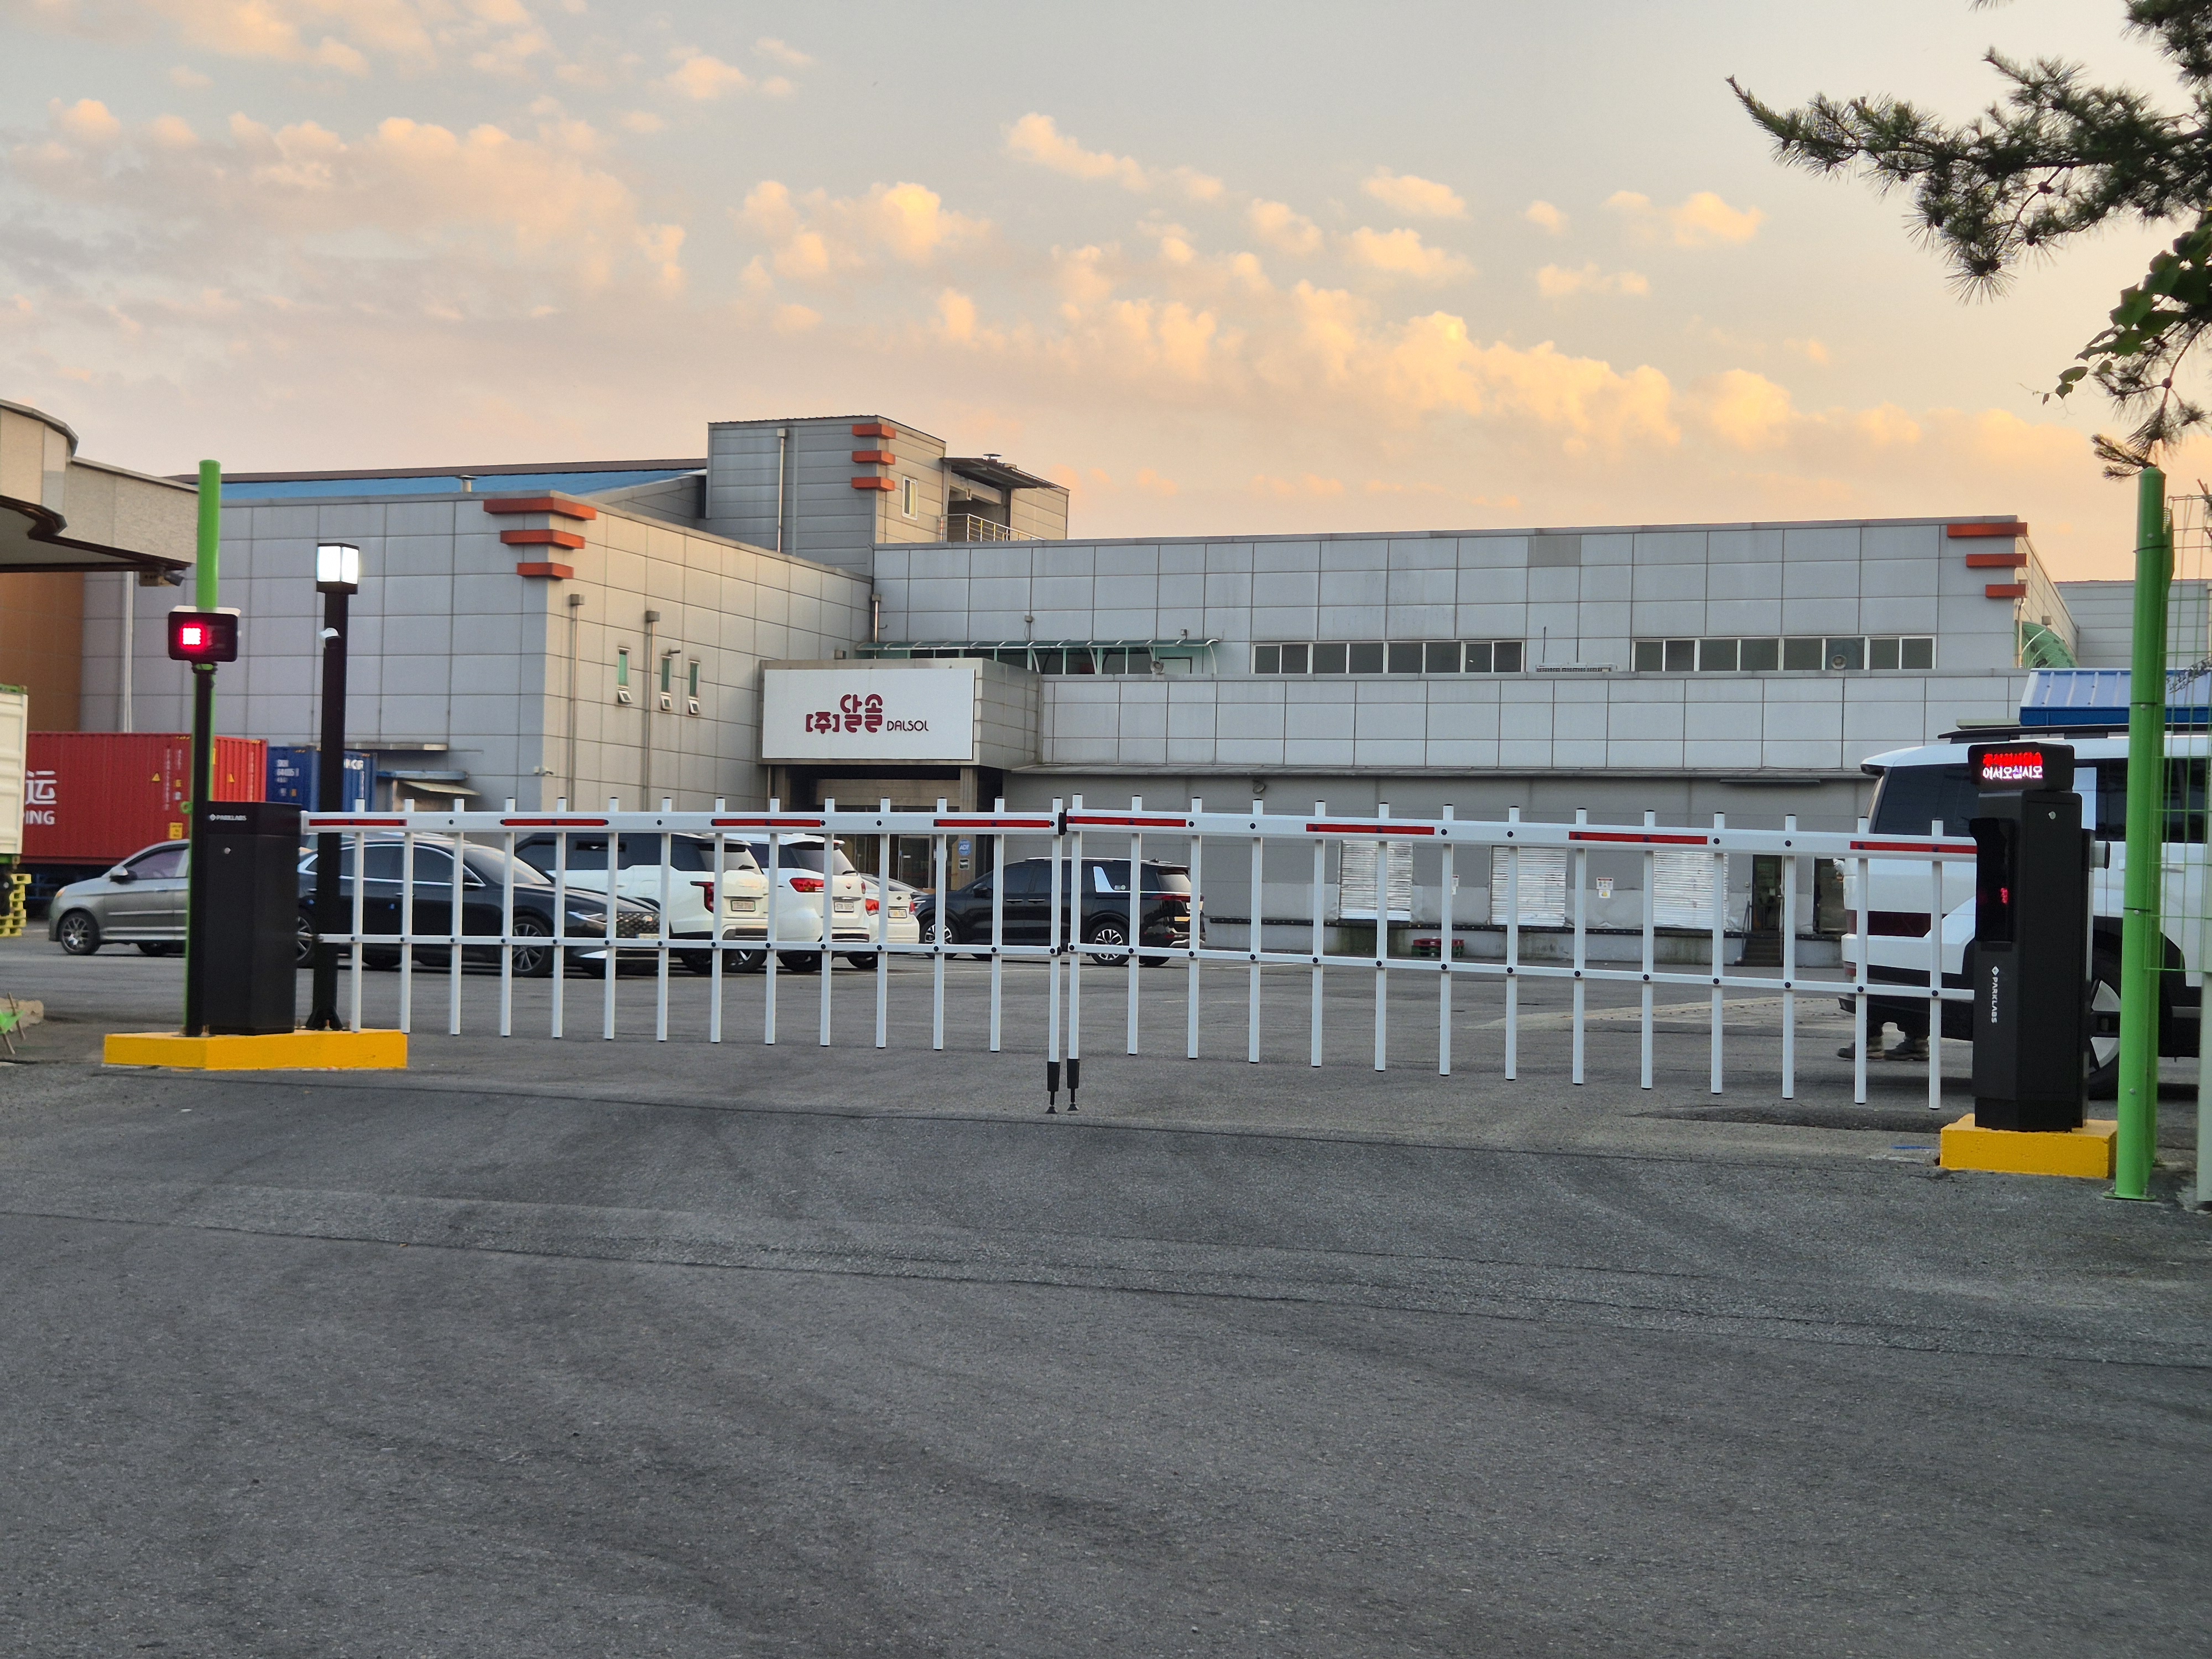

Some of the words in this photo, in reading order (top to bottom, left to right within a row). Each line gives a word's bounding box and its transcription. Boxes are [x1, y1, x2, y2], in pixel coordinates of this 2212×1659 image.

[886, 719, 929, 732] DALSOL
[1983, 765, 2043, 780] 어서오십시오
[24, 810, 55, 825] ING
